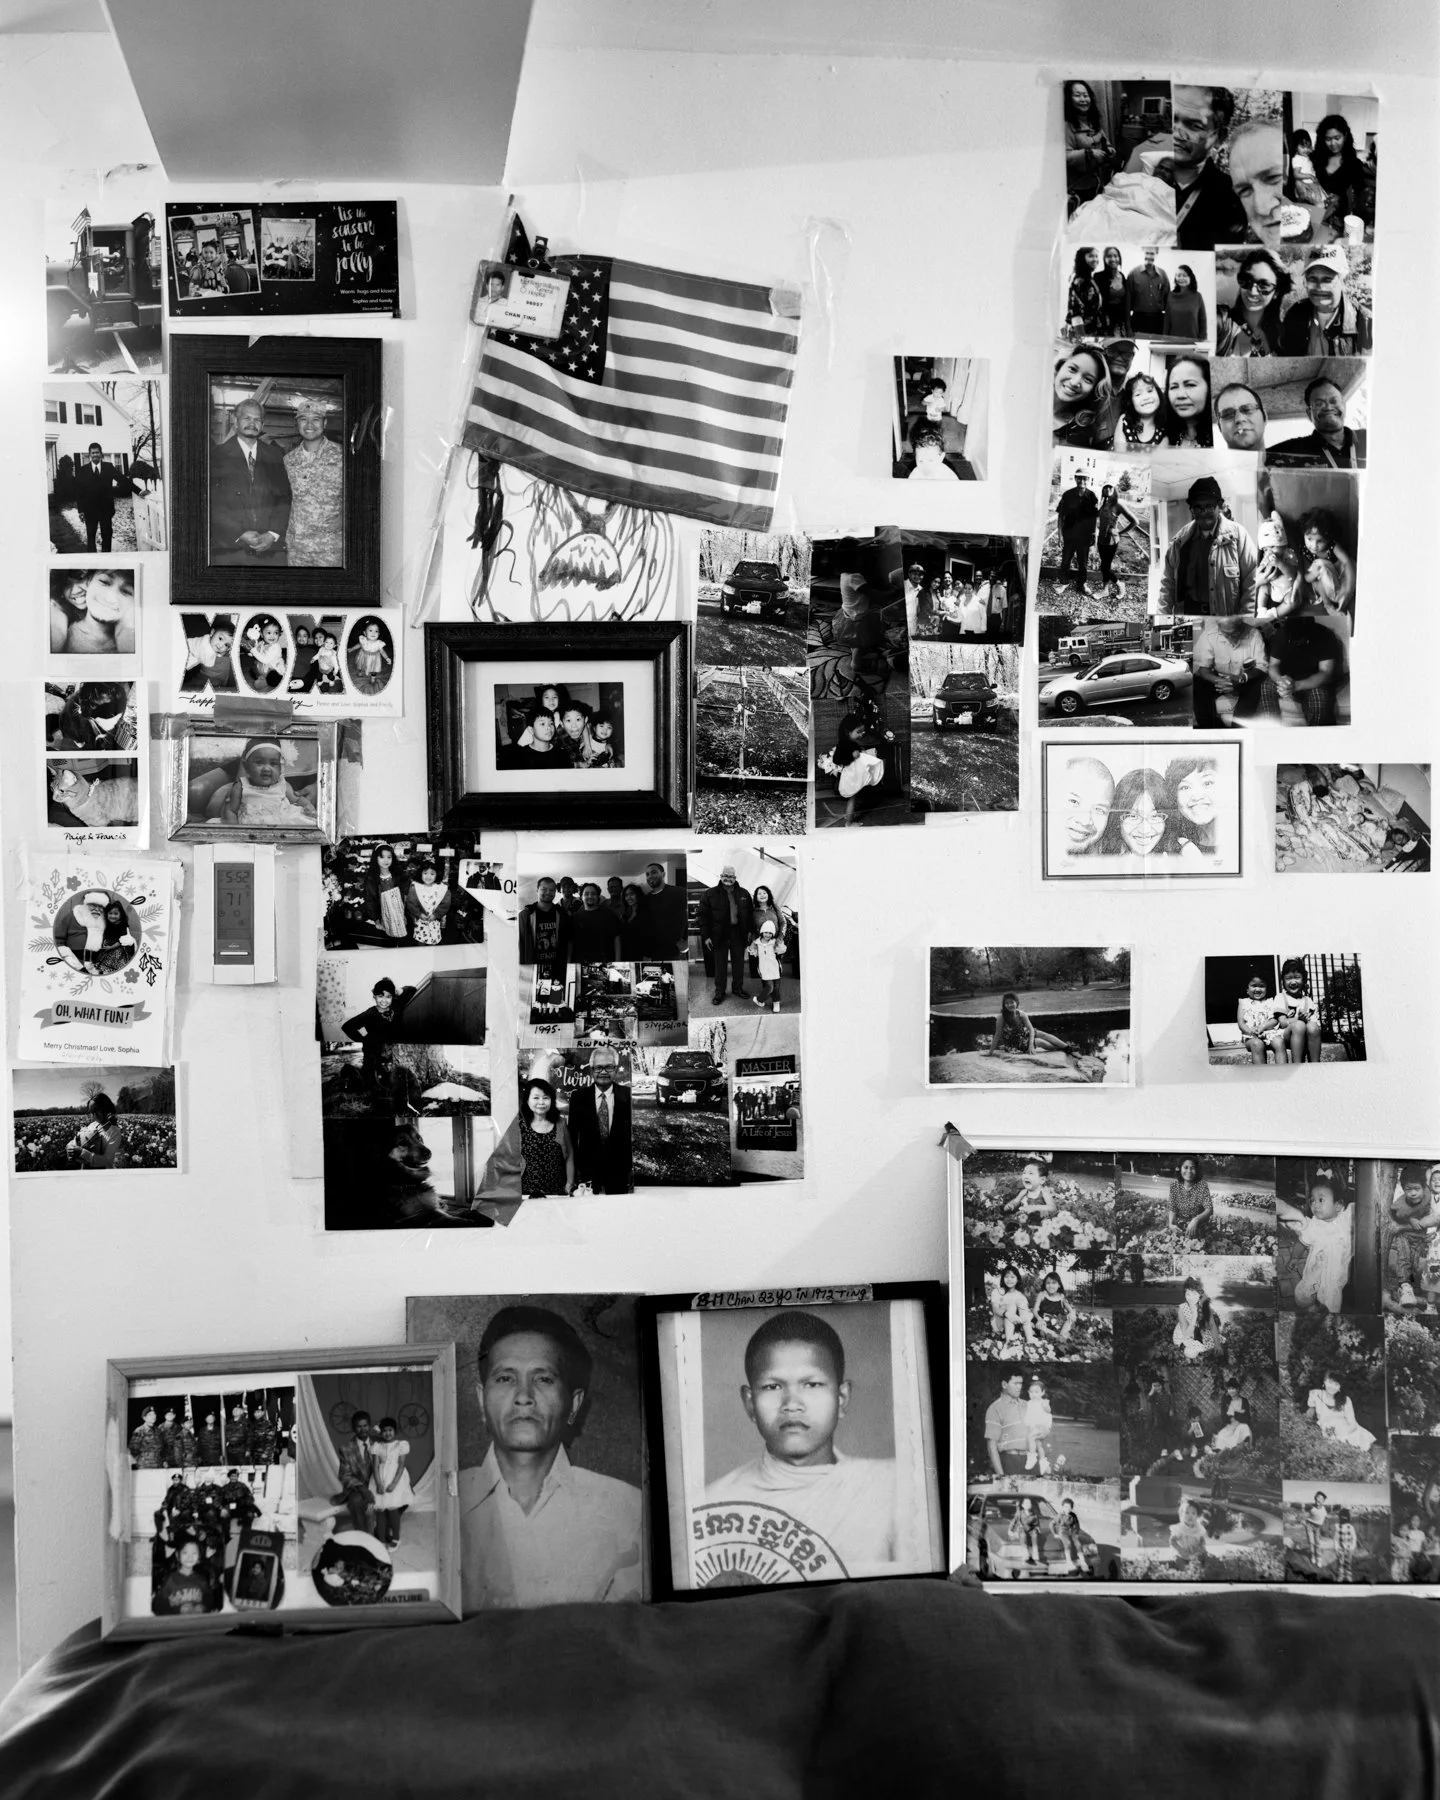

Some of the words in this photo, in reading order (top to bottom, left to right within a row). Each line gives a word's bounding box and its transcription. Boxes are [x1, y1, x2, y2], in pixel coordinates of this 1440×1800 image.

[332, 220, 375, 239] season
[342, 239, 351, 252] to
[354, 235, 364, 249] be
[335, 251, 373, 285] jolly
[357, 288, 369, 296] hugs
[64, 832, 87, 846] Paige
[95, 832, 127, 840] Francis
[227, 892, 241, 906] 71
[55, 1003, 72, 1018] OH,
[74, 1006, 103, 1021] WHAT
[104, 1009, 130, 1025] FUN!
[43, 1042, 62, 1050] Merry
[64, 1043, 98, 1051] Christmas!
[118, 1046, 140, 1054] Sophia
[742, 1060, 791, 1073] MASTER
[551, 1065, 595, 1087] Twin
[742, 1128, 749, 1137] A
[750, 1126, 764, 1137] Life
[764, 1126, 773, 1137] of
[773, 1126, 793, 1139] Jesus
[381, 1594, 423, 1603] NATURE
